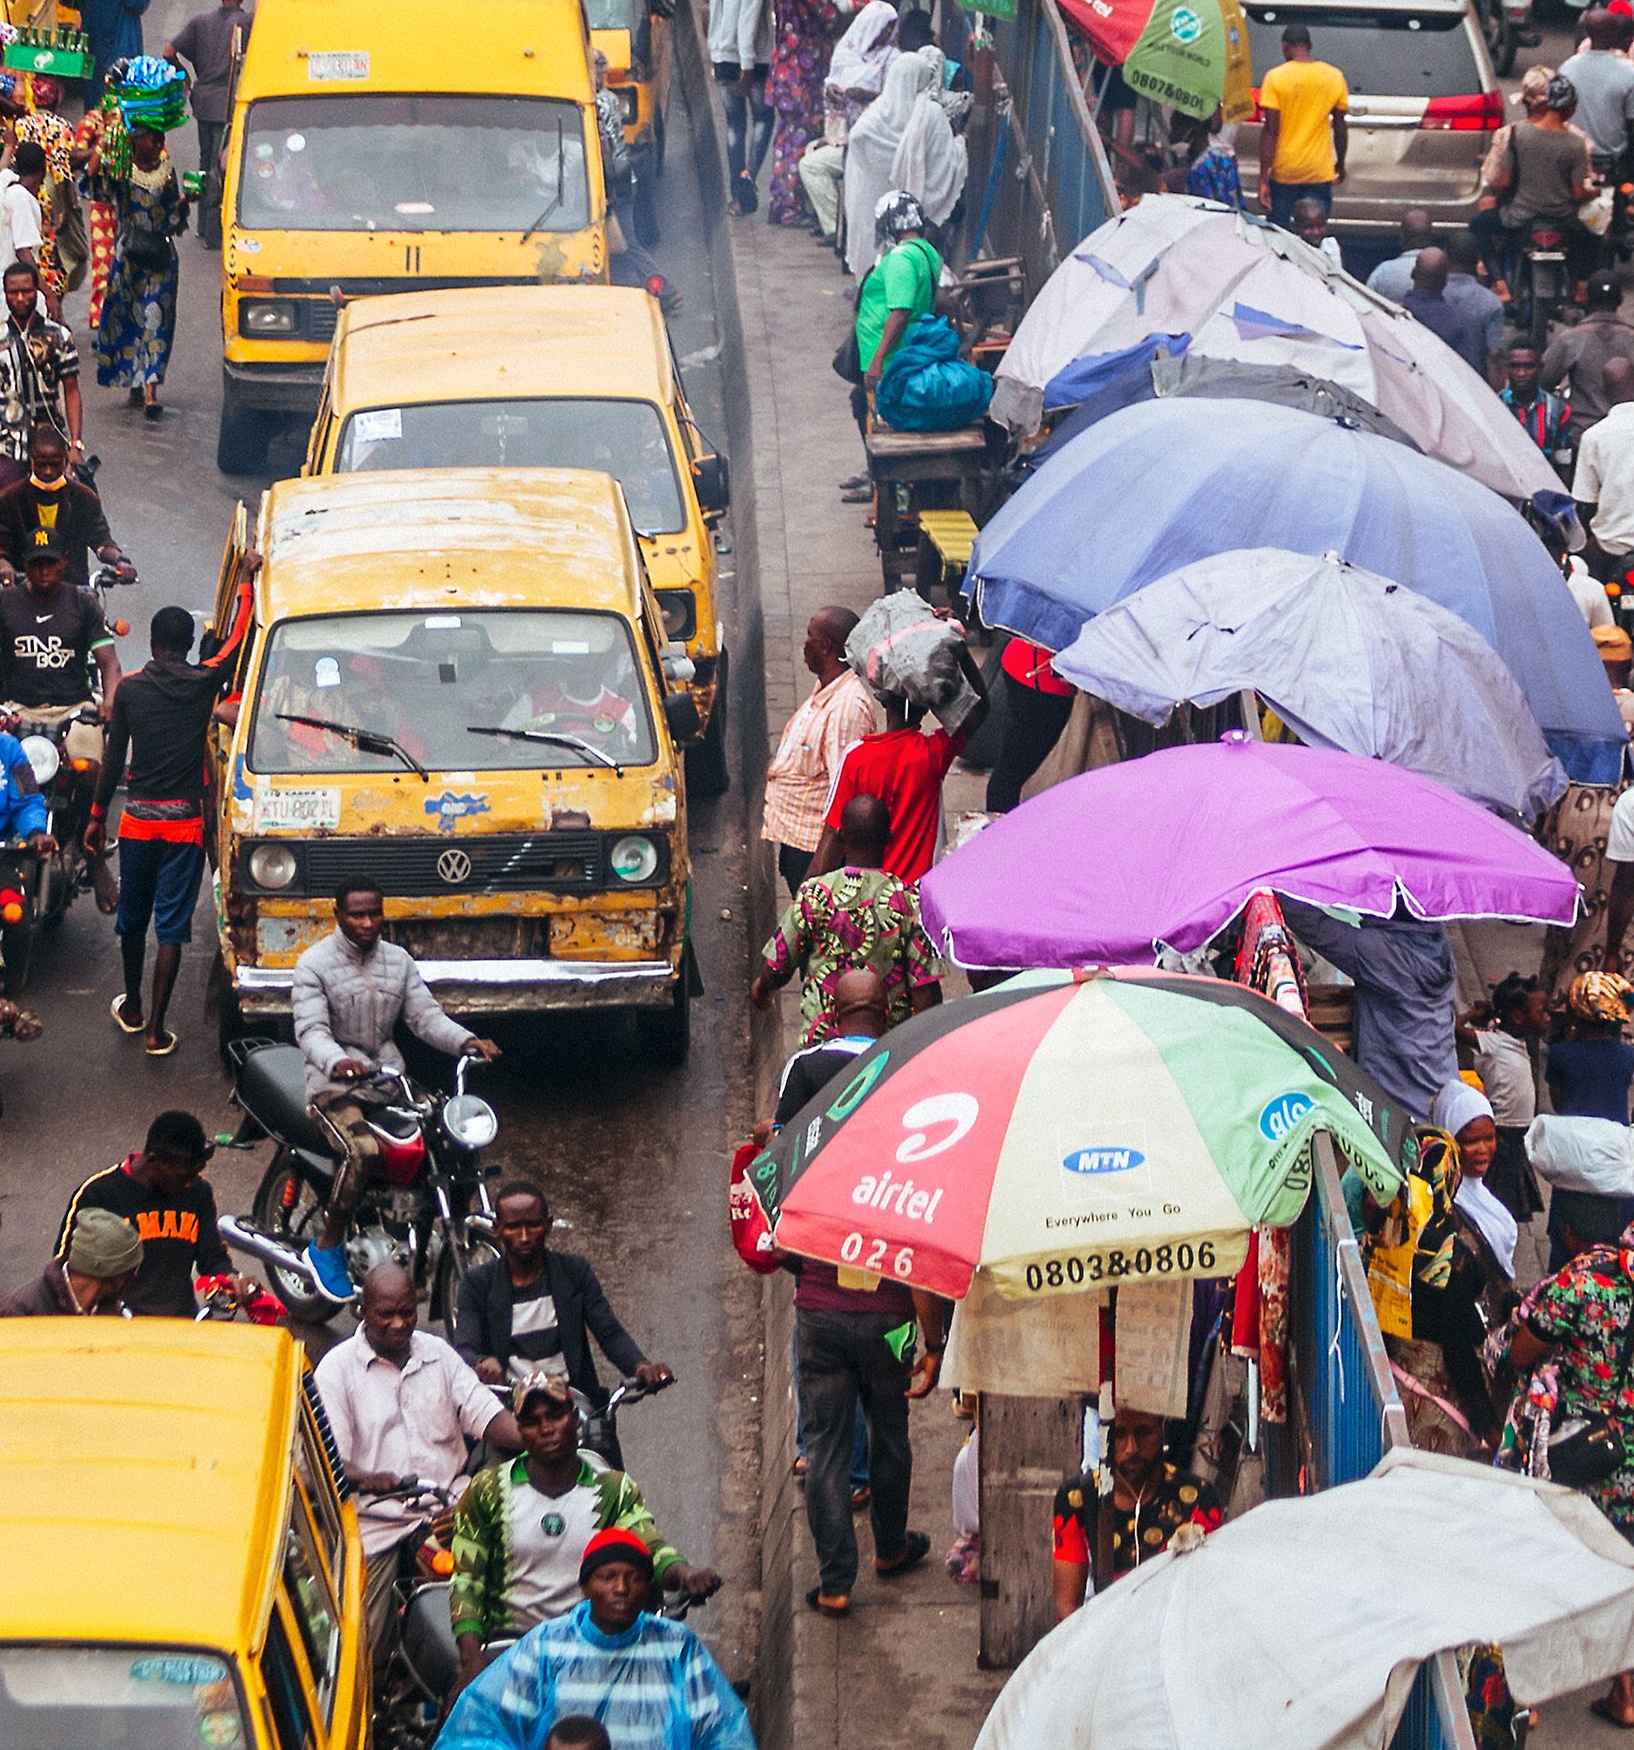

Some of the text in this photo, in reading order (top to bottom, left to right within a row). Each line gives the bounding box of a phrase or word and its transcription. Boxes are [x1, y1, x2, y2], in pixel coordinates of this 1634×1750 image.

[36, 649, 76, 668] BOY
[1078, 1151, 1130, 1172] MTN
[852, 1170, 944, 1225] airtel
[1045, 1202, 1182, 1230] Everywhere You Go
[840, 1232, 915, 1278] 026
[1025, 1240, 1217, 1292] 0803&0806
